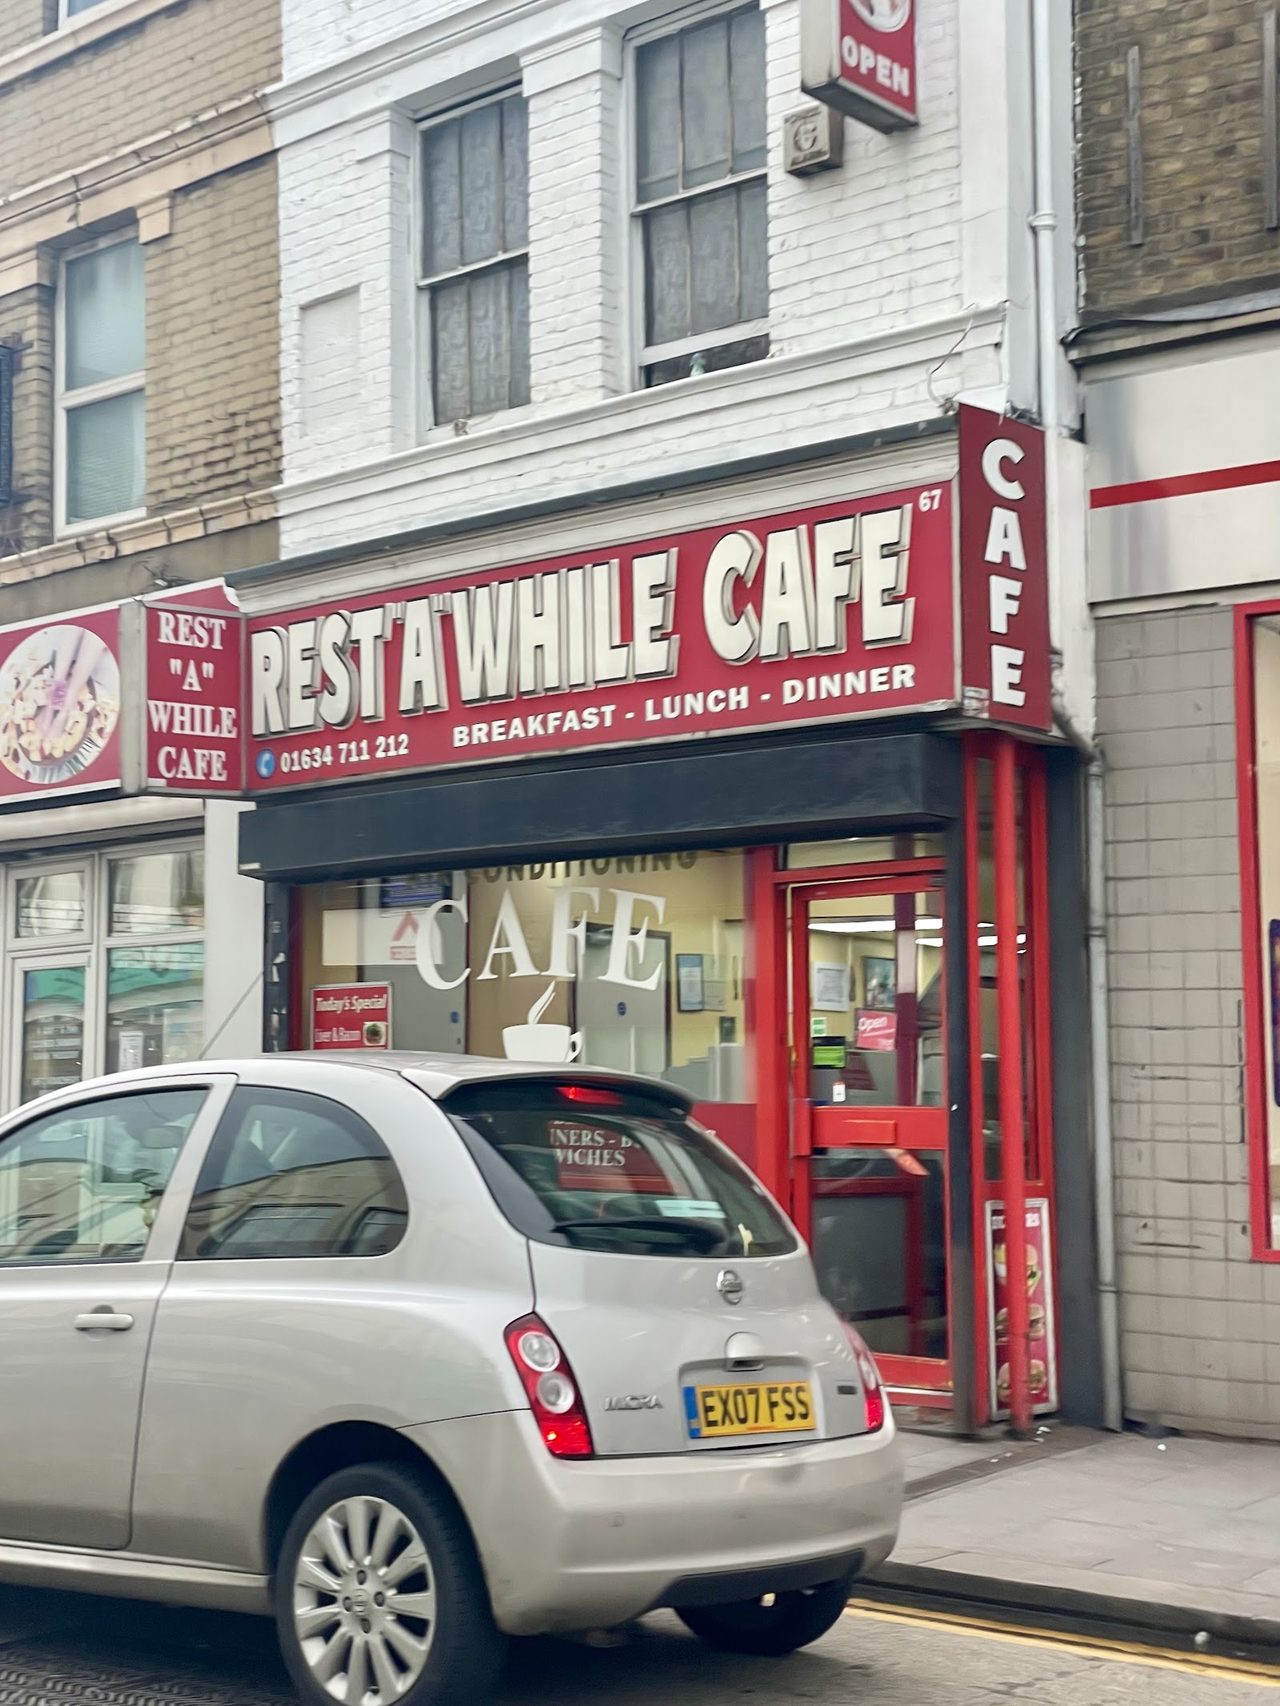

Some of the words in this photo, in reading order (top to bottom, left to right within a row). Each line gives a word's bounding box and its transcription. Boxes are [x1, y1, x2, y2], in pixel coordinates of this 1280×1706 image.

[842, 35, 910, 97] OPEN
[918, 489, 942, 512] 67
[982, 438, 1027, 707] CAFE
[157, 611, 227, 650] REST
[251, 604, 392, 741] REST
[450, 547, 680, 708] WHILE
[703, 503, 916, 666] CAFE
[147, 700, 237, 738] WHILE
[453, 705, 616, 747] BREAKFAST
[645, 686, 749, 721] LUNCH
[782, 664, 916, 705] DINNER
[157, 746, 228, 782] CAFE
[280, 745, 333, 773] 01634
[338, 739, 370, 763] 711
[375, 734, 409, 758] 212
[415, 886, 666, 991] CAFE
[858, 1016, 888, 1032] Open
[702, 1388, 760, 1427] EX07
[766, 1385, 809, 1422] FSS
